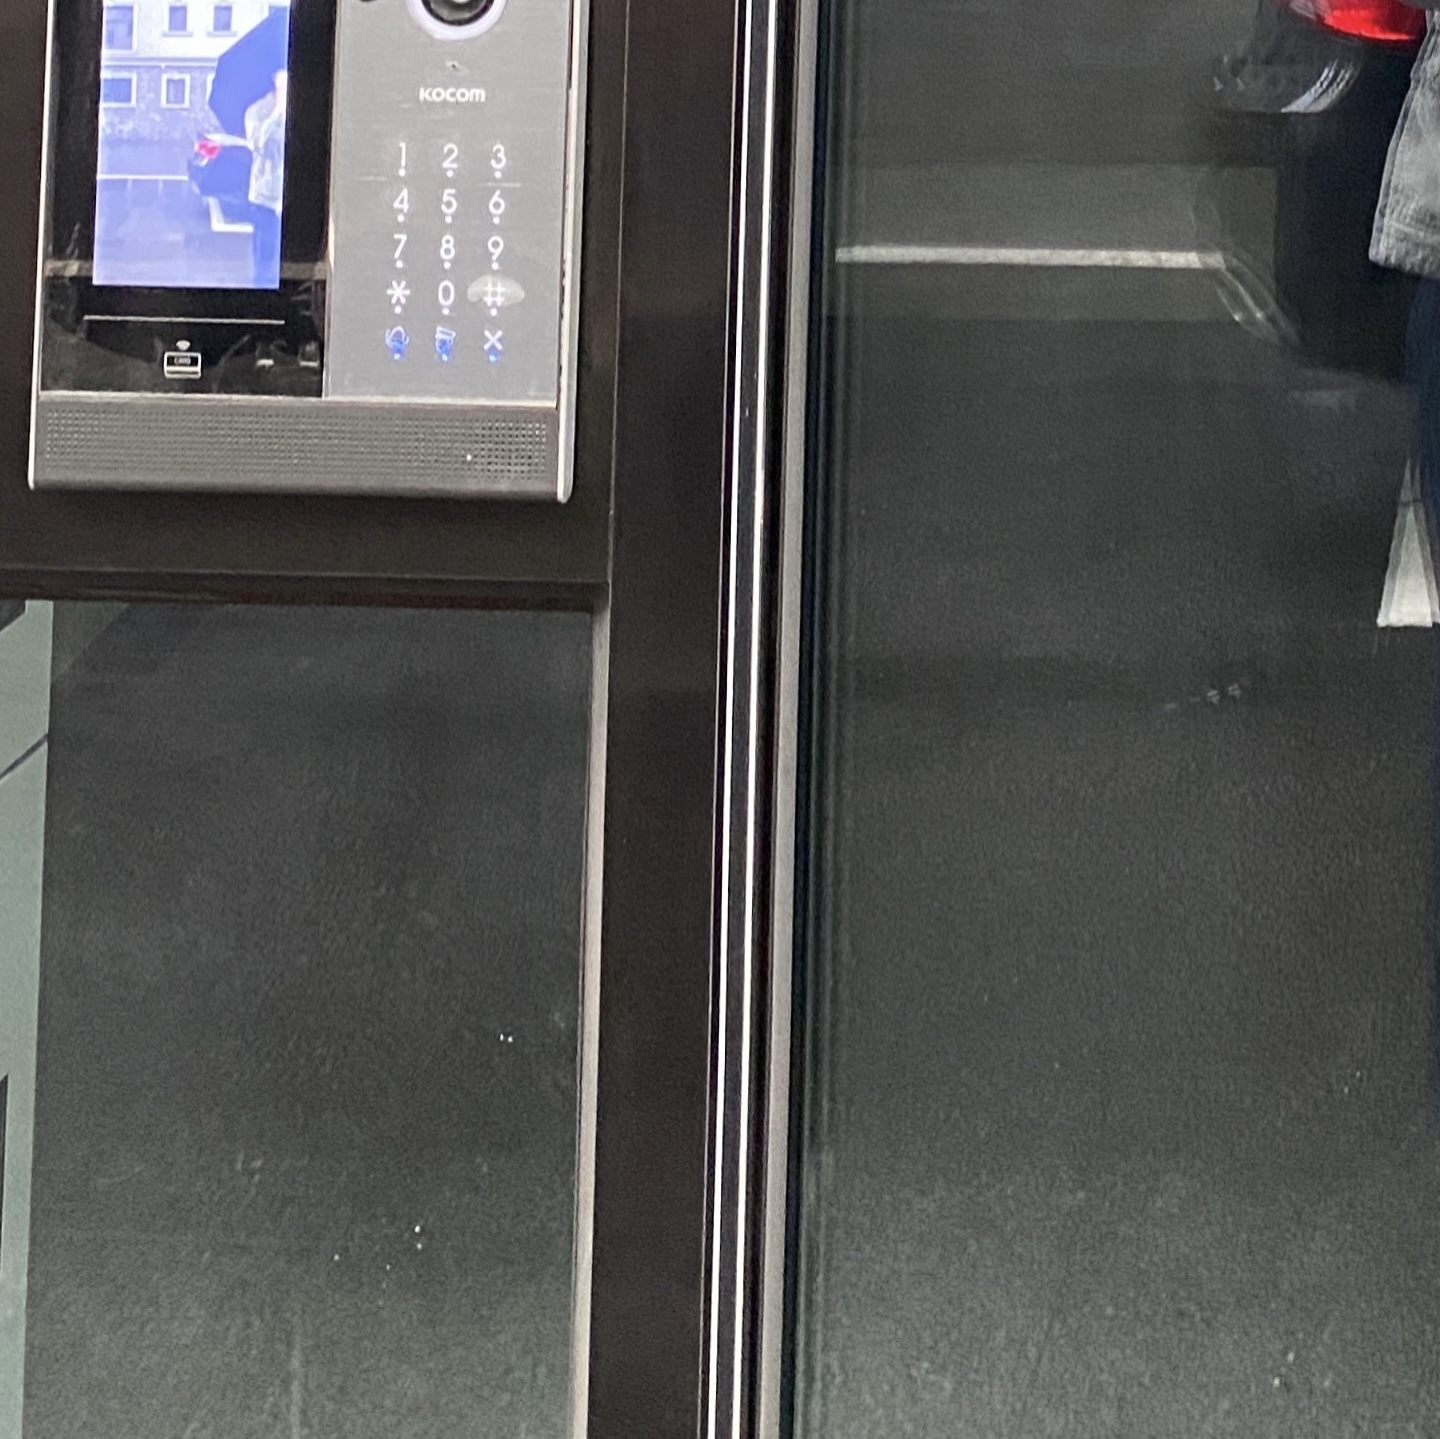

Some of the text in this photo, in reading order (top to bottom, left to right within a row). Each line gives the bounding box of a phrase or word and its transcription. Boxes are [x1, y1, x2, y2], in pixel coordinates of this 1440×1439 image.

[442, 143, 458, 169] 2
[491, 144, 507, 169] 3
[393, 188, 505, 215] 4 5 6
[393, 234, 504, 261] 7 8 9
[438, 280, 455, 306] 0
